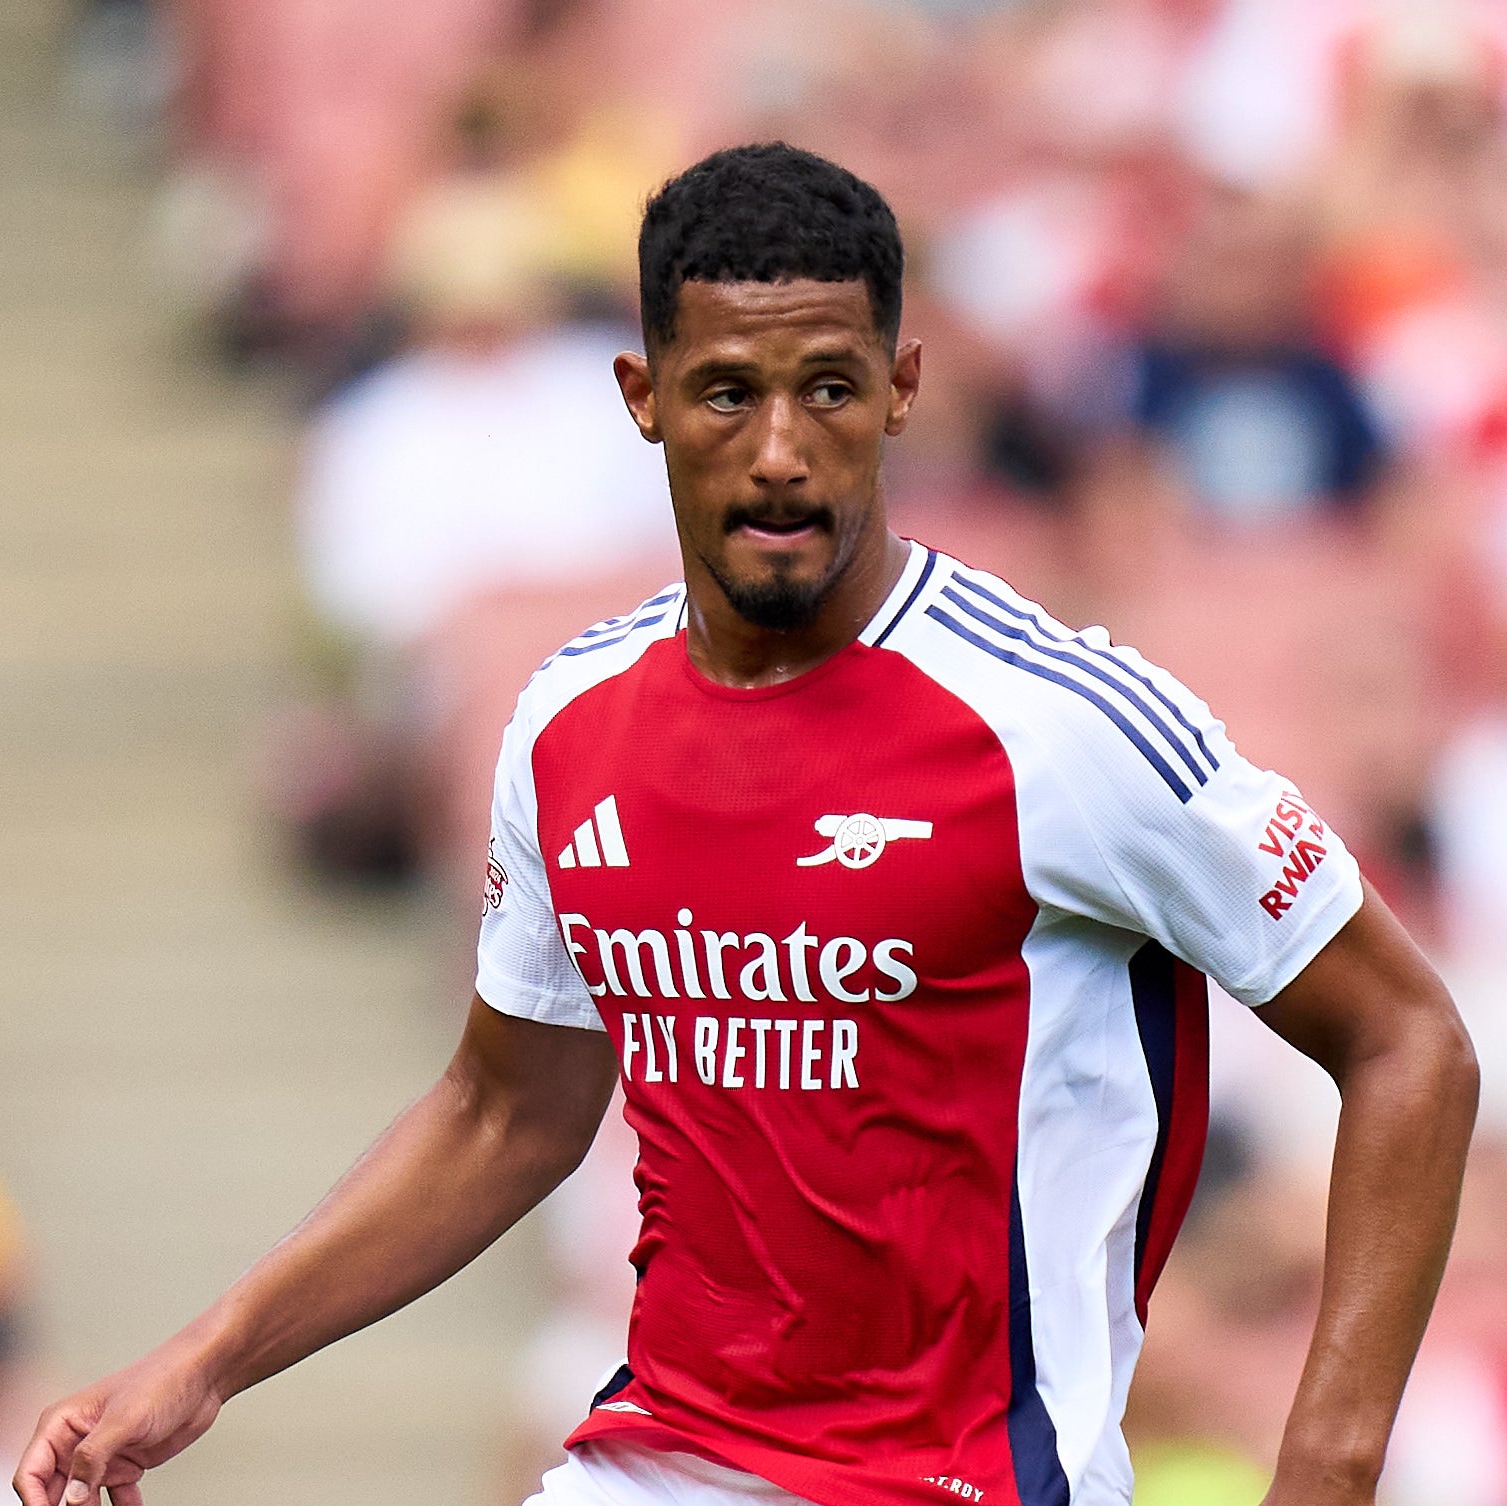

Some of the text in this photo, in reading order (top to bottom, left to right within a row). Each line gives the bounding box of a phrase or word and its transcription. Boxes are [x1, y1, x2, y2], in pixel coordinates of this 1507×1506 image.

[559, 907, 918, 1003] Emirates
[622, 1012, 860, 1090] FLY BETTER
